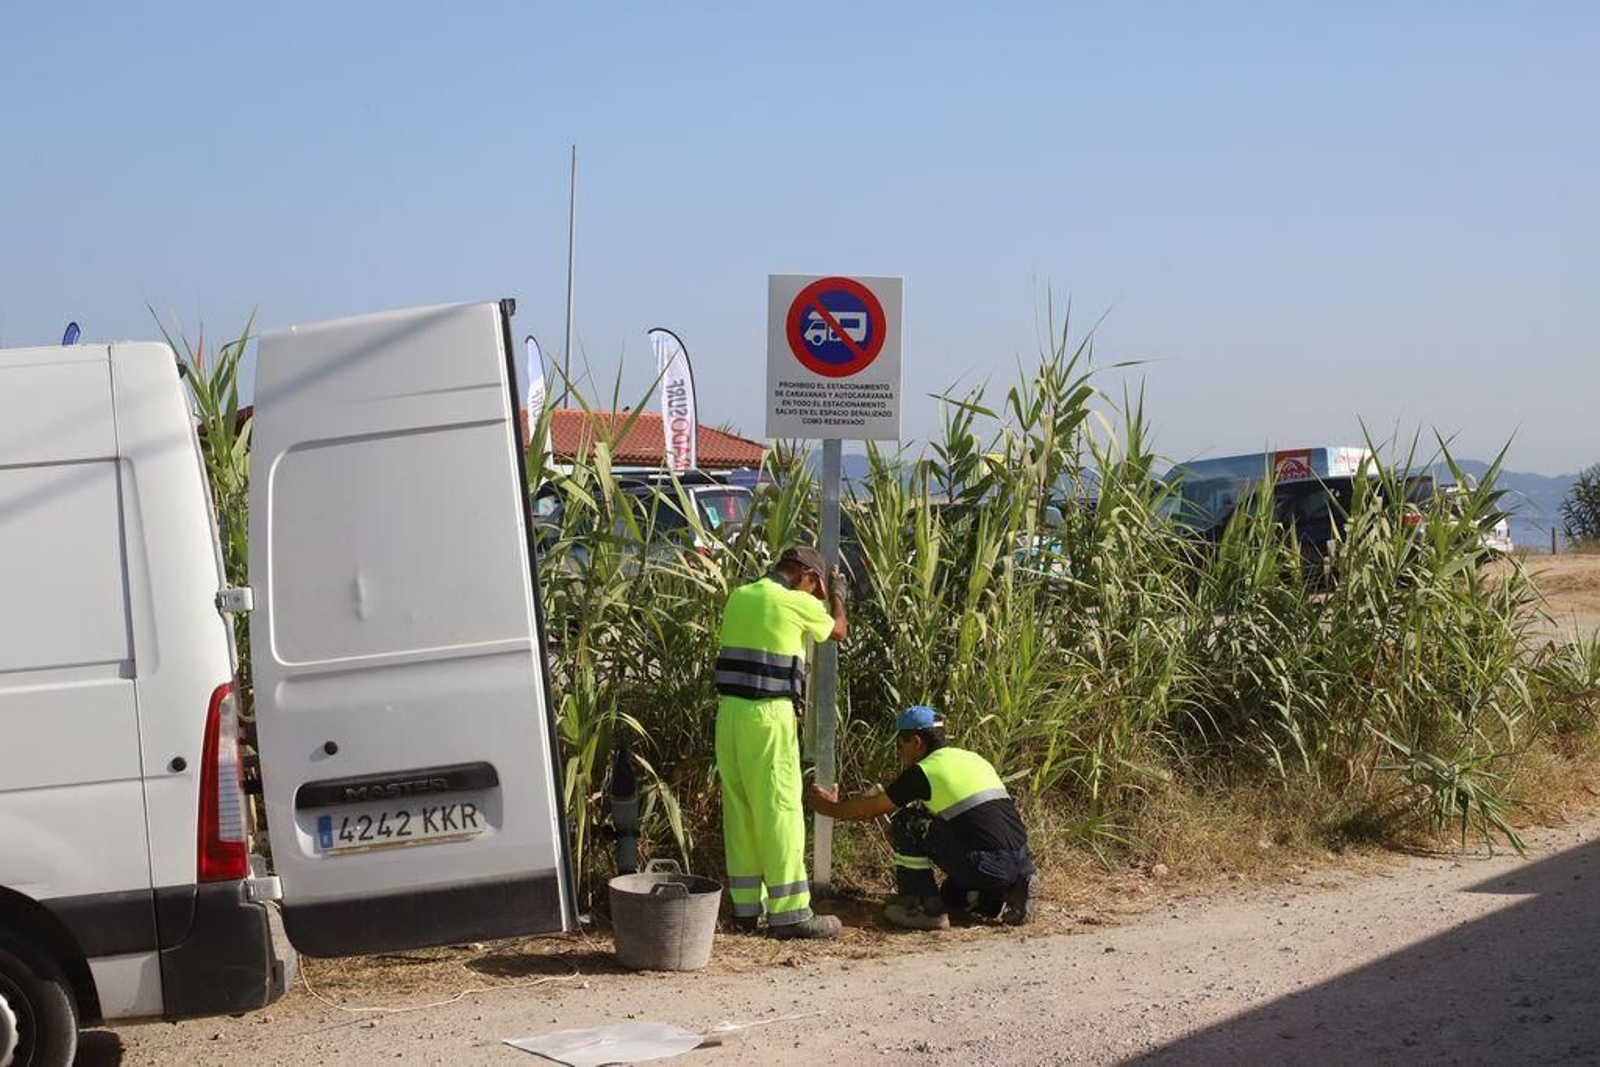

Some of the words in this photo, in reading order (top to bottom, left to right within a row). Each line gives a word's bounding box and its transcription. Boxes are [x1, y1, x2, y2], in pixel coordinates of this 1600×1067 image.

[779, 381, 815, 390] PROHIBIDO
[817, 382, 826, 390] EL
[827, 383, 890, 391] ESTACIONAMIENTO
[785, 390, 827, 399] CARAVANAS
[834, 391, 894, 400] AUTOCARAVANAS
[781, 399, 792, 407] EN
[822, 401, 887, 409] ESTACIONAMIENTO
[775, 408, 798, 416] SALVO
[799, 408, 808, 416] EN
[820, 409, 849, 417] ESPACIO
[801, 417, 823, 425] COMO
[824, 418, 866, 426] RESERVADO
[345, 778, 449, 800] MASTER
[339, 811, 412, 842] 4242
[422, 803, 478, 833] KKR
